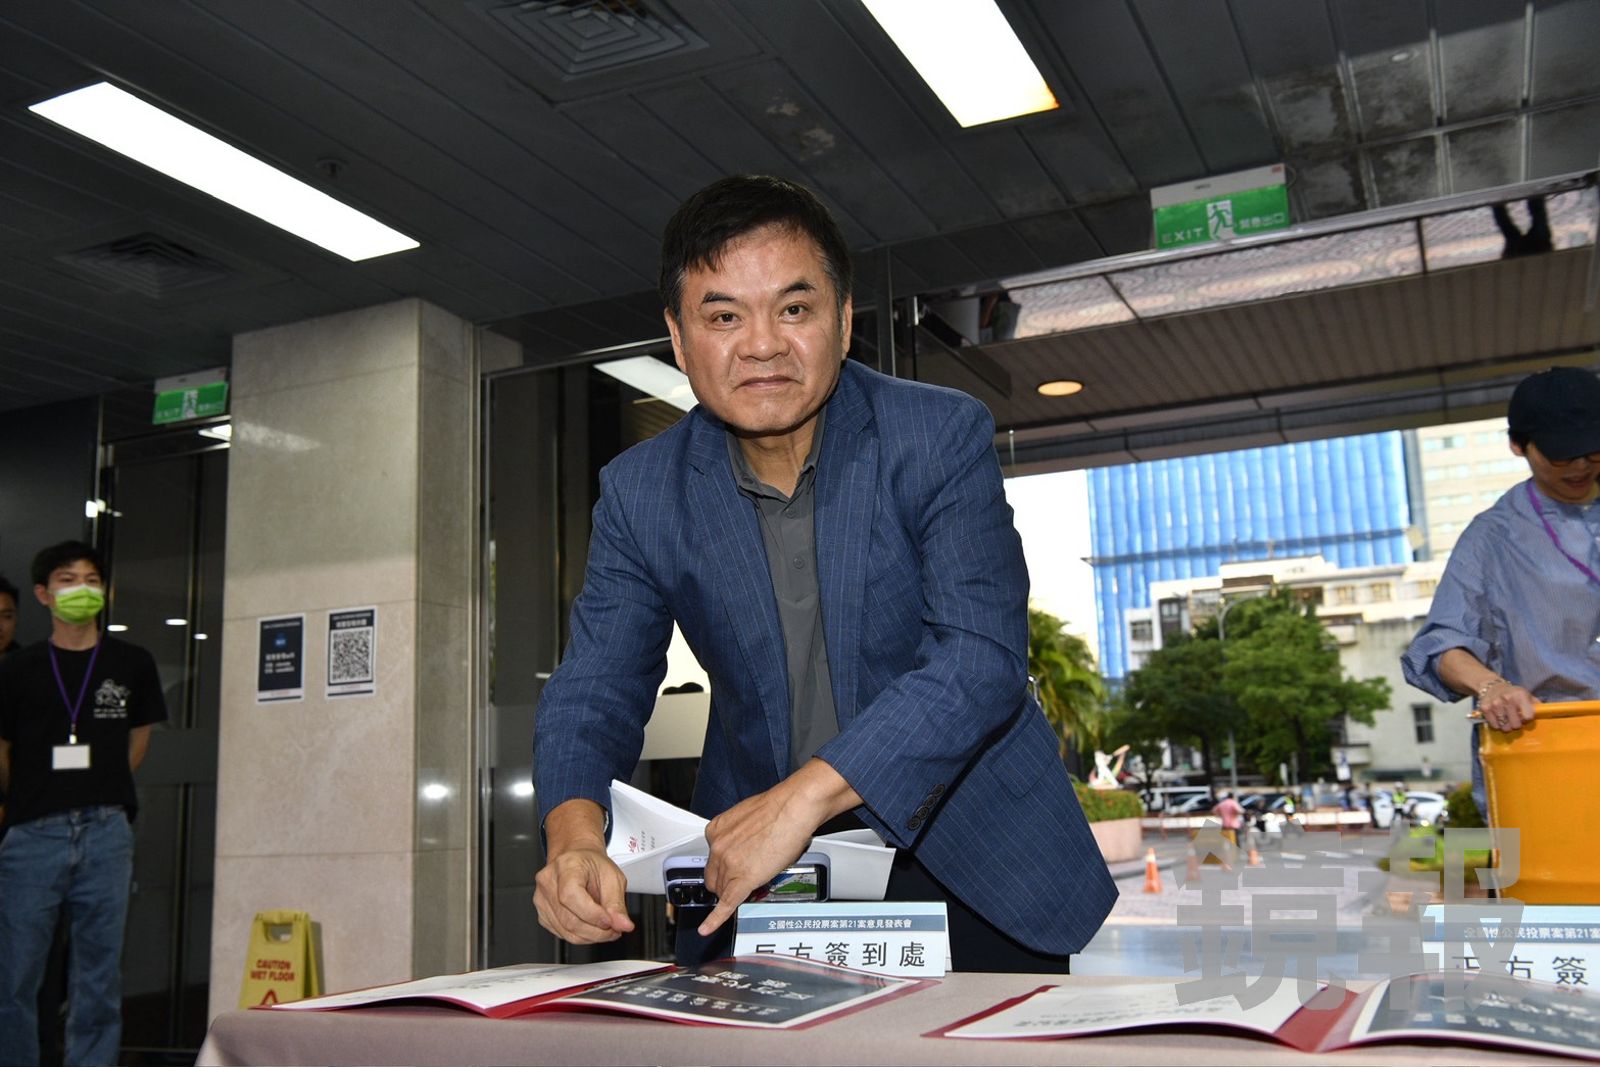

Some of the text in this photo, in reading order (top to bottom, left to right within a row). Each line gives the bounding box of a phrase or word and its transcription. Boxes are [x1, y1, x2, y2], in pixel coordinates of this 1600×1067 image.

[1162, 226, 1203, 243] EXIT
[768, 919, 912, 930] 全國性公民投票案第21案意見發表會
[256, 959, 291, 970] CAUTION
[250, 971, 295, 982] WET FLOOR
